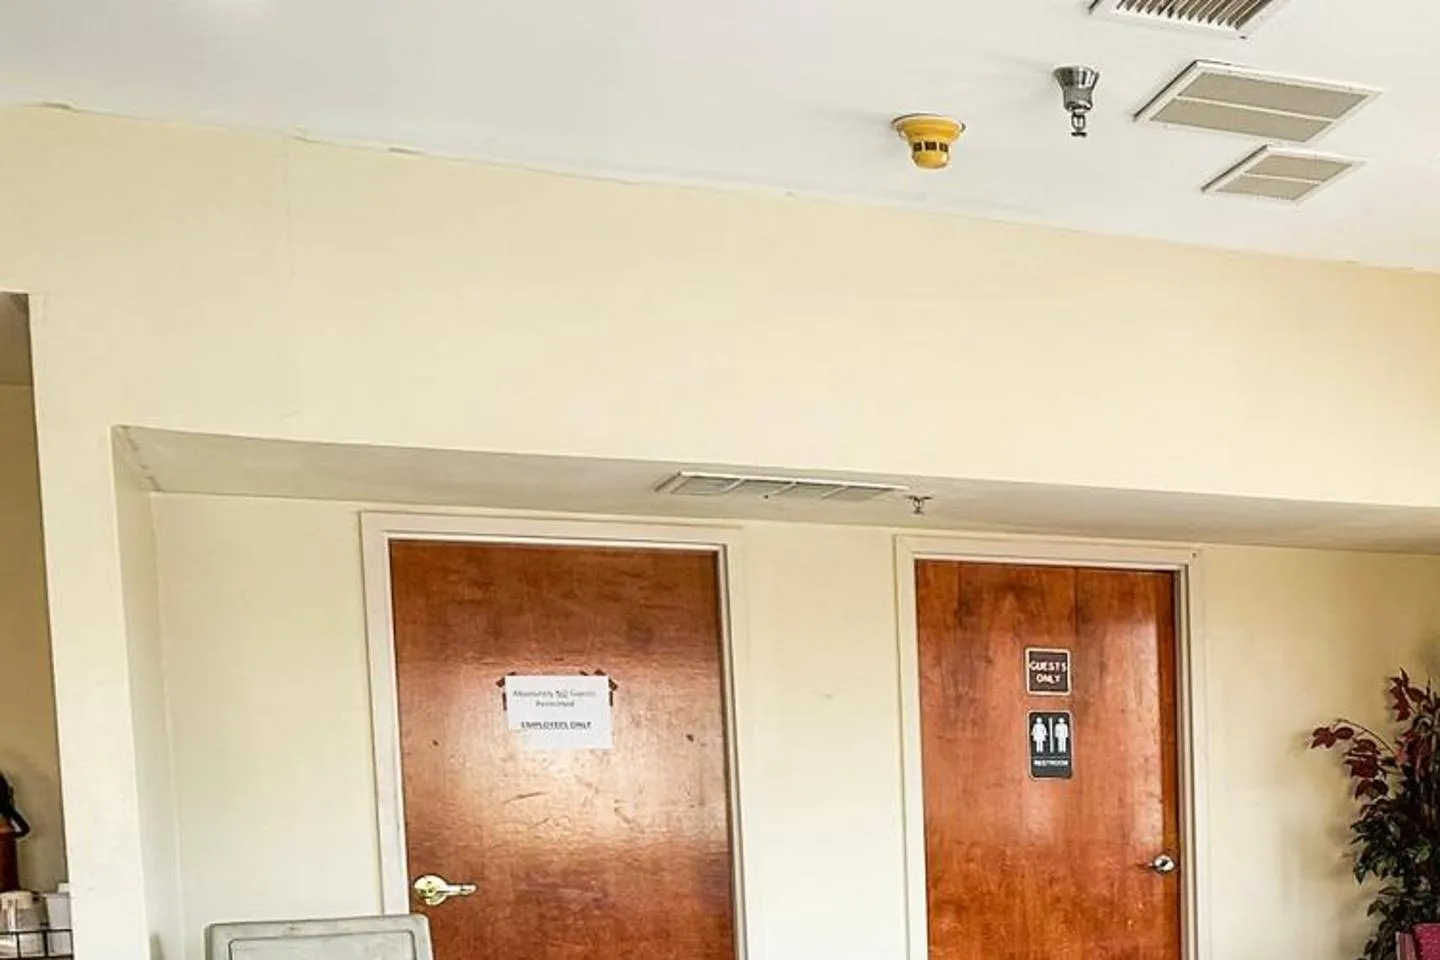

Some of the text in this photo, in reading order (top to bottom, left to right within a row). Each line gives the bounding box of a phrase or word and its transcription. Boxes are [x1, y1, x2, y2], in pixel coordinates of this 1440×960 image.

[1030, 661, 1067, 672] GUESTS
[1036, 673, 1061, 684] ONLY
[570, 721, 592, 730] ONLY
